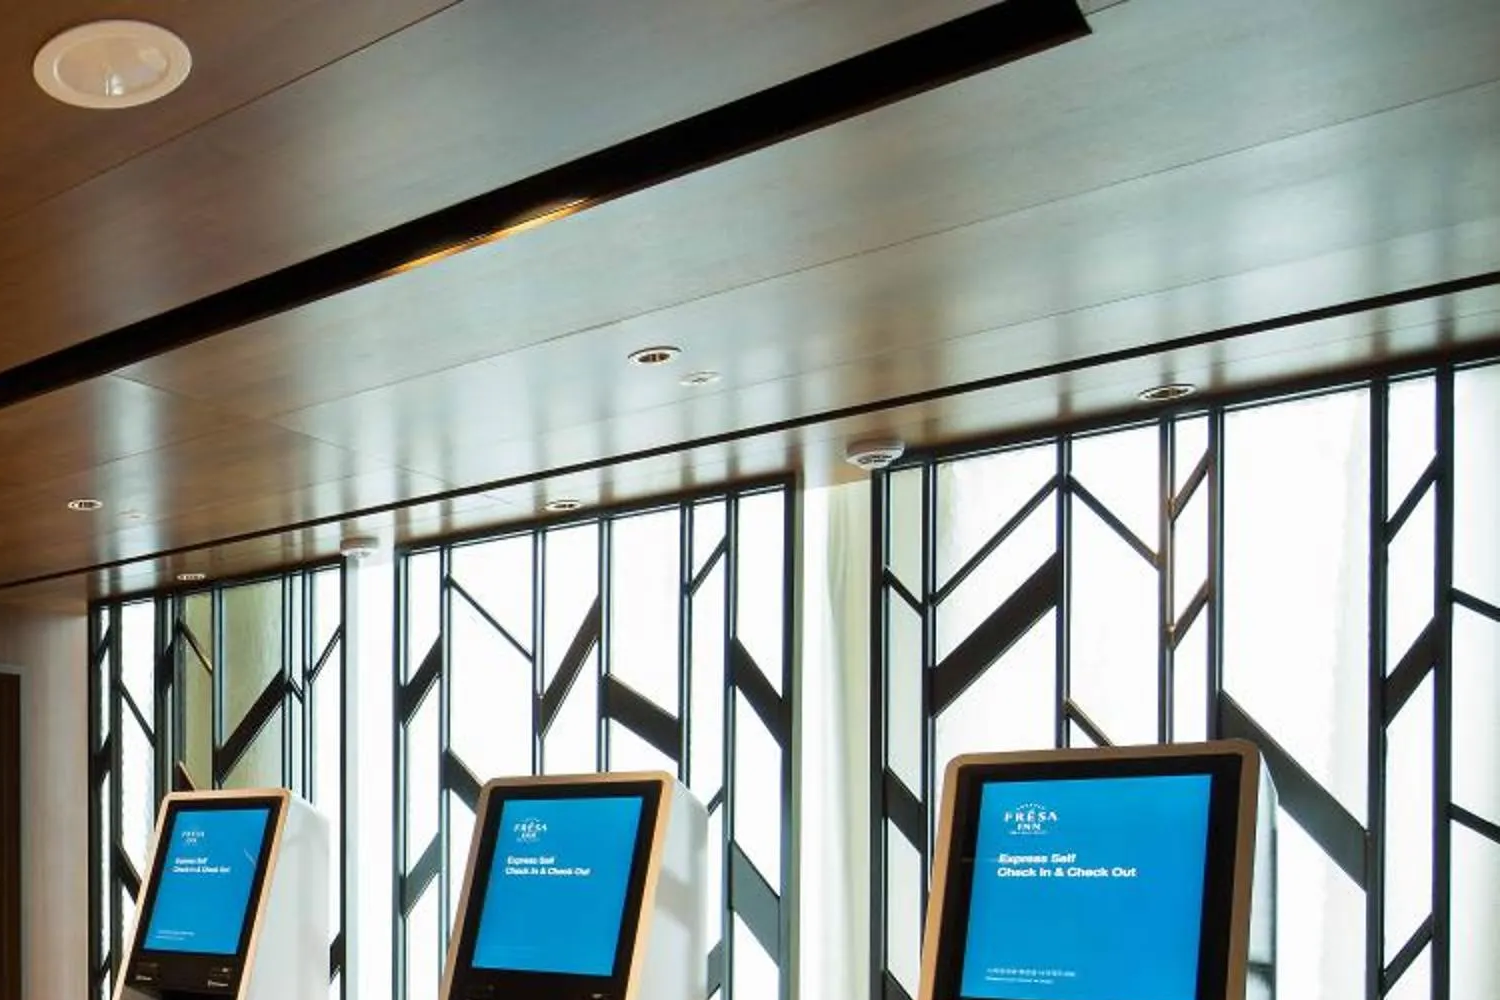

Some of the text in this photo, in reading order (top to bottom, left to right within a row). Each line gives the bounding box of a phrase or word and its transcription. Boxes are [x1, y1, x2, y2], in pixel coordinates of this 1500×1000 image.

[998, 853, 1077, 865] Express Self
[997, 867, 1137, 877] Check In & Check Out
